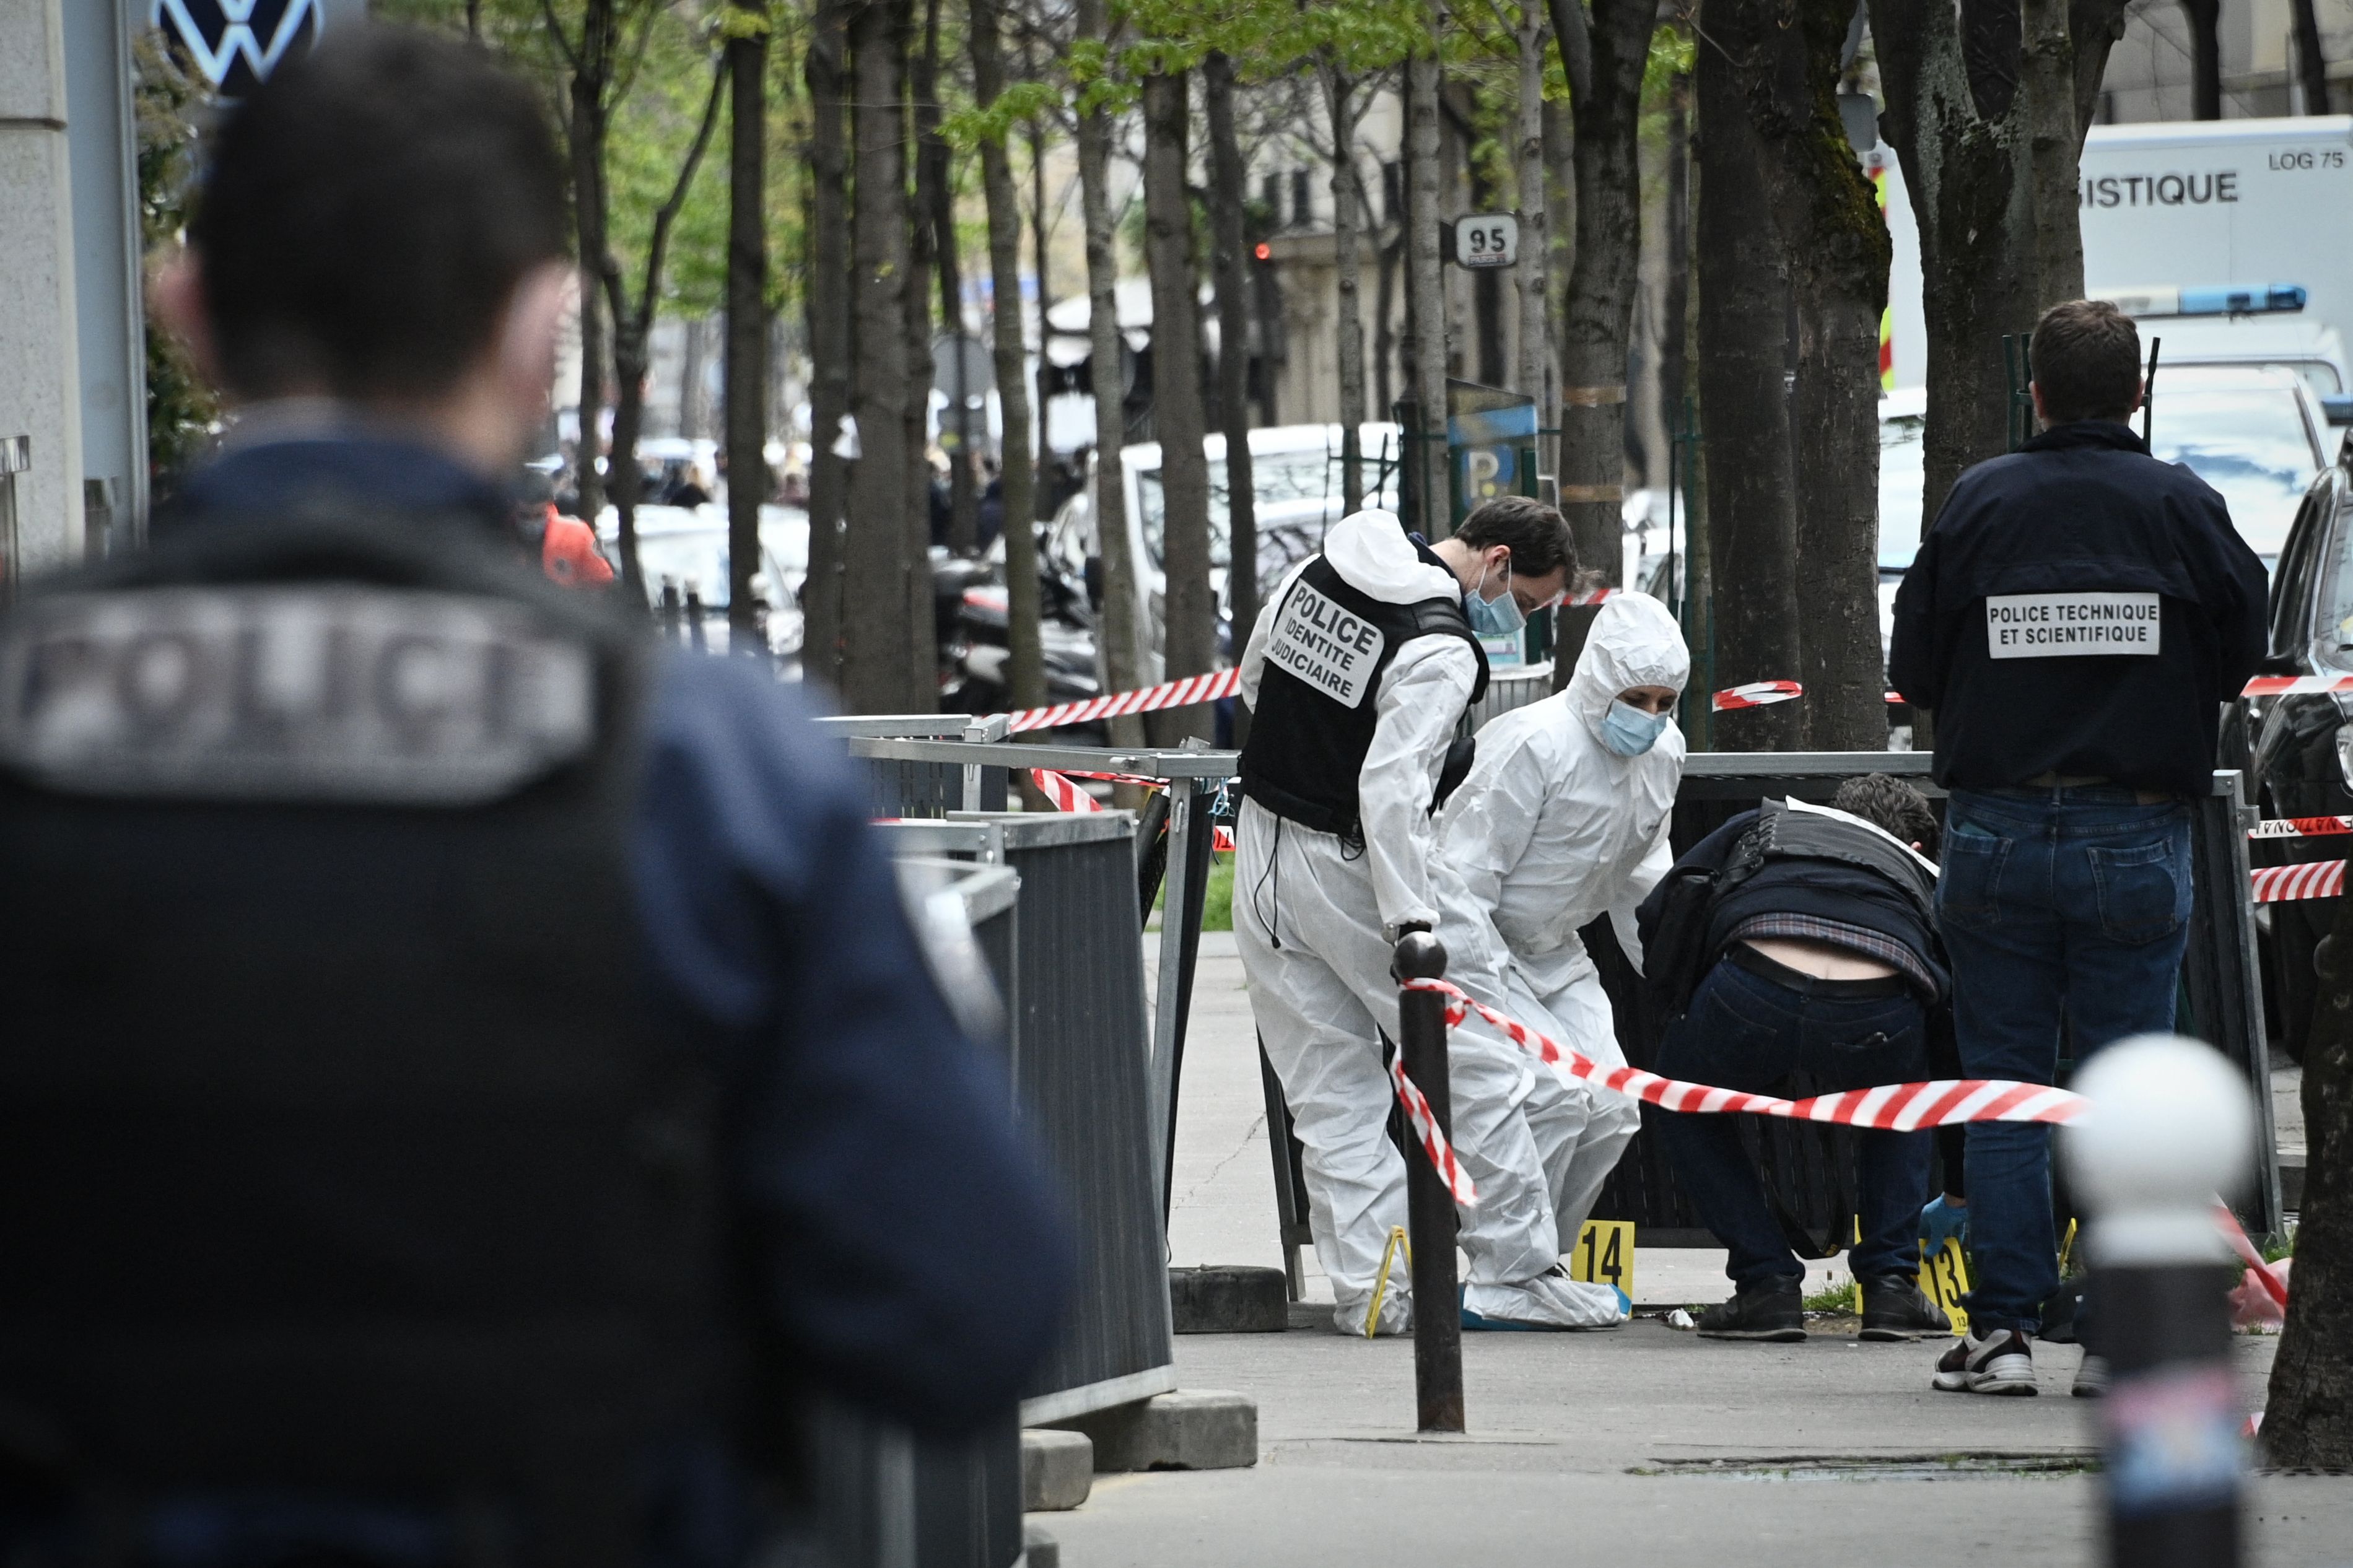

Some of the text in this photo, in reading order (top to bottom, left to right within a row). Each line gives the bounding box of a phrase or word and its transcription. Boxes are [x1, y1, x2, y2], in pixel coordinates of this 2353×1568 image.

[2268, 151, 2343, 171] LOG 75
[2078, 173, 2238, 208] ISTIQUE
[1470, 227, 1506, 253] 95
[1468, 451, 1499, 499] P
[1290, 586, 1377, 656] POLICE
[1989, 604, 2157, 623] POLICE TECHNIQUE
[1285, 617, 1355, 671] IDENTITE
[2000, 626, 2147, 645] ET SCIENTIFIQUE
[1272, 638, 1353, 698] JUDICIAIRE
[1582, 1226, 1622, 1288] 14
[1923, 1244, 1962, 1309] 13
[1957, 1316, 1967, 1327] 13
